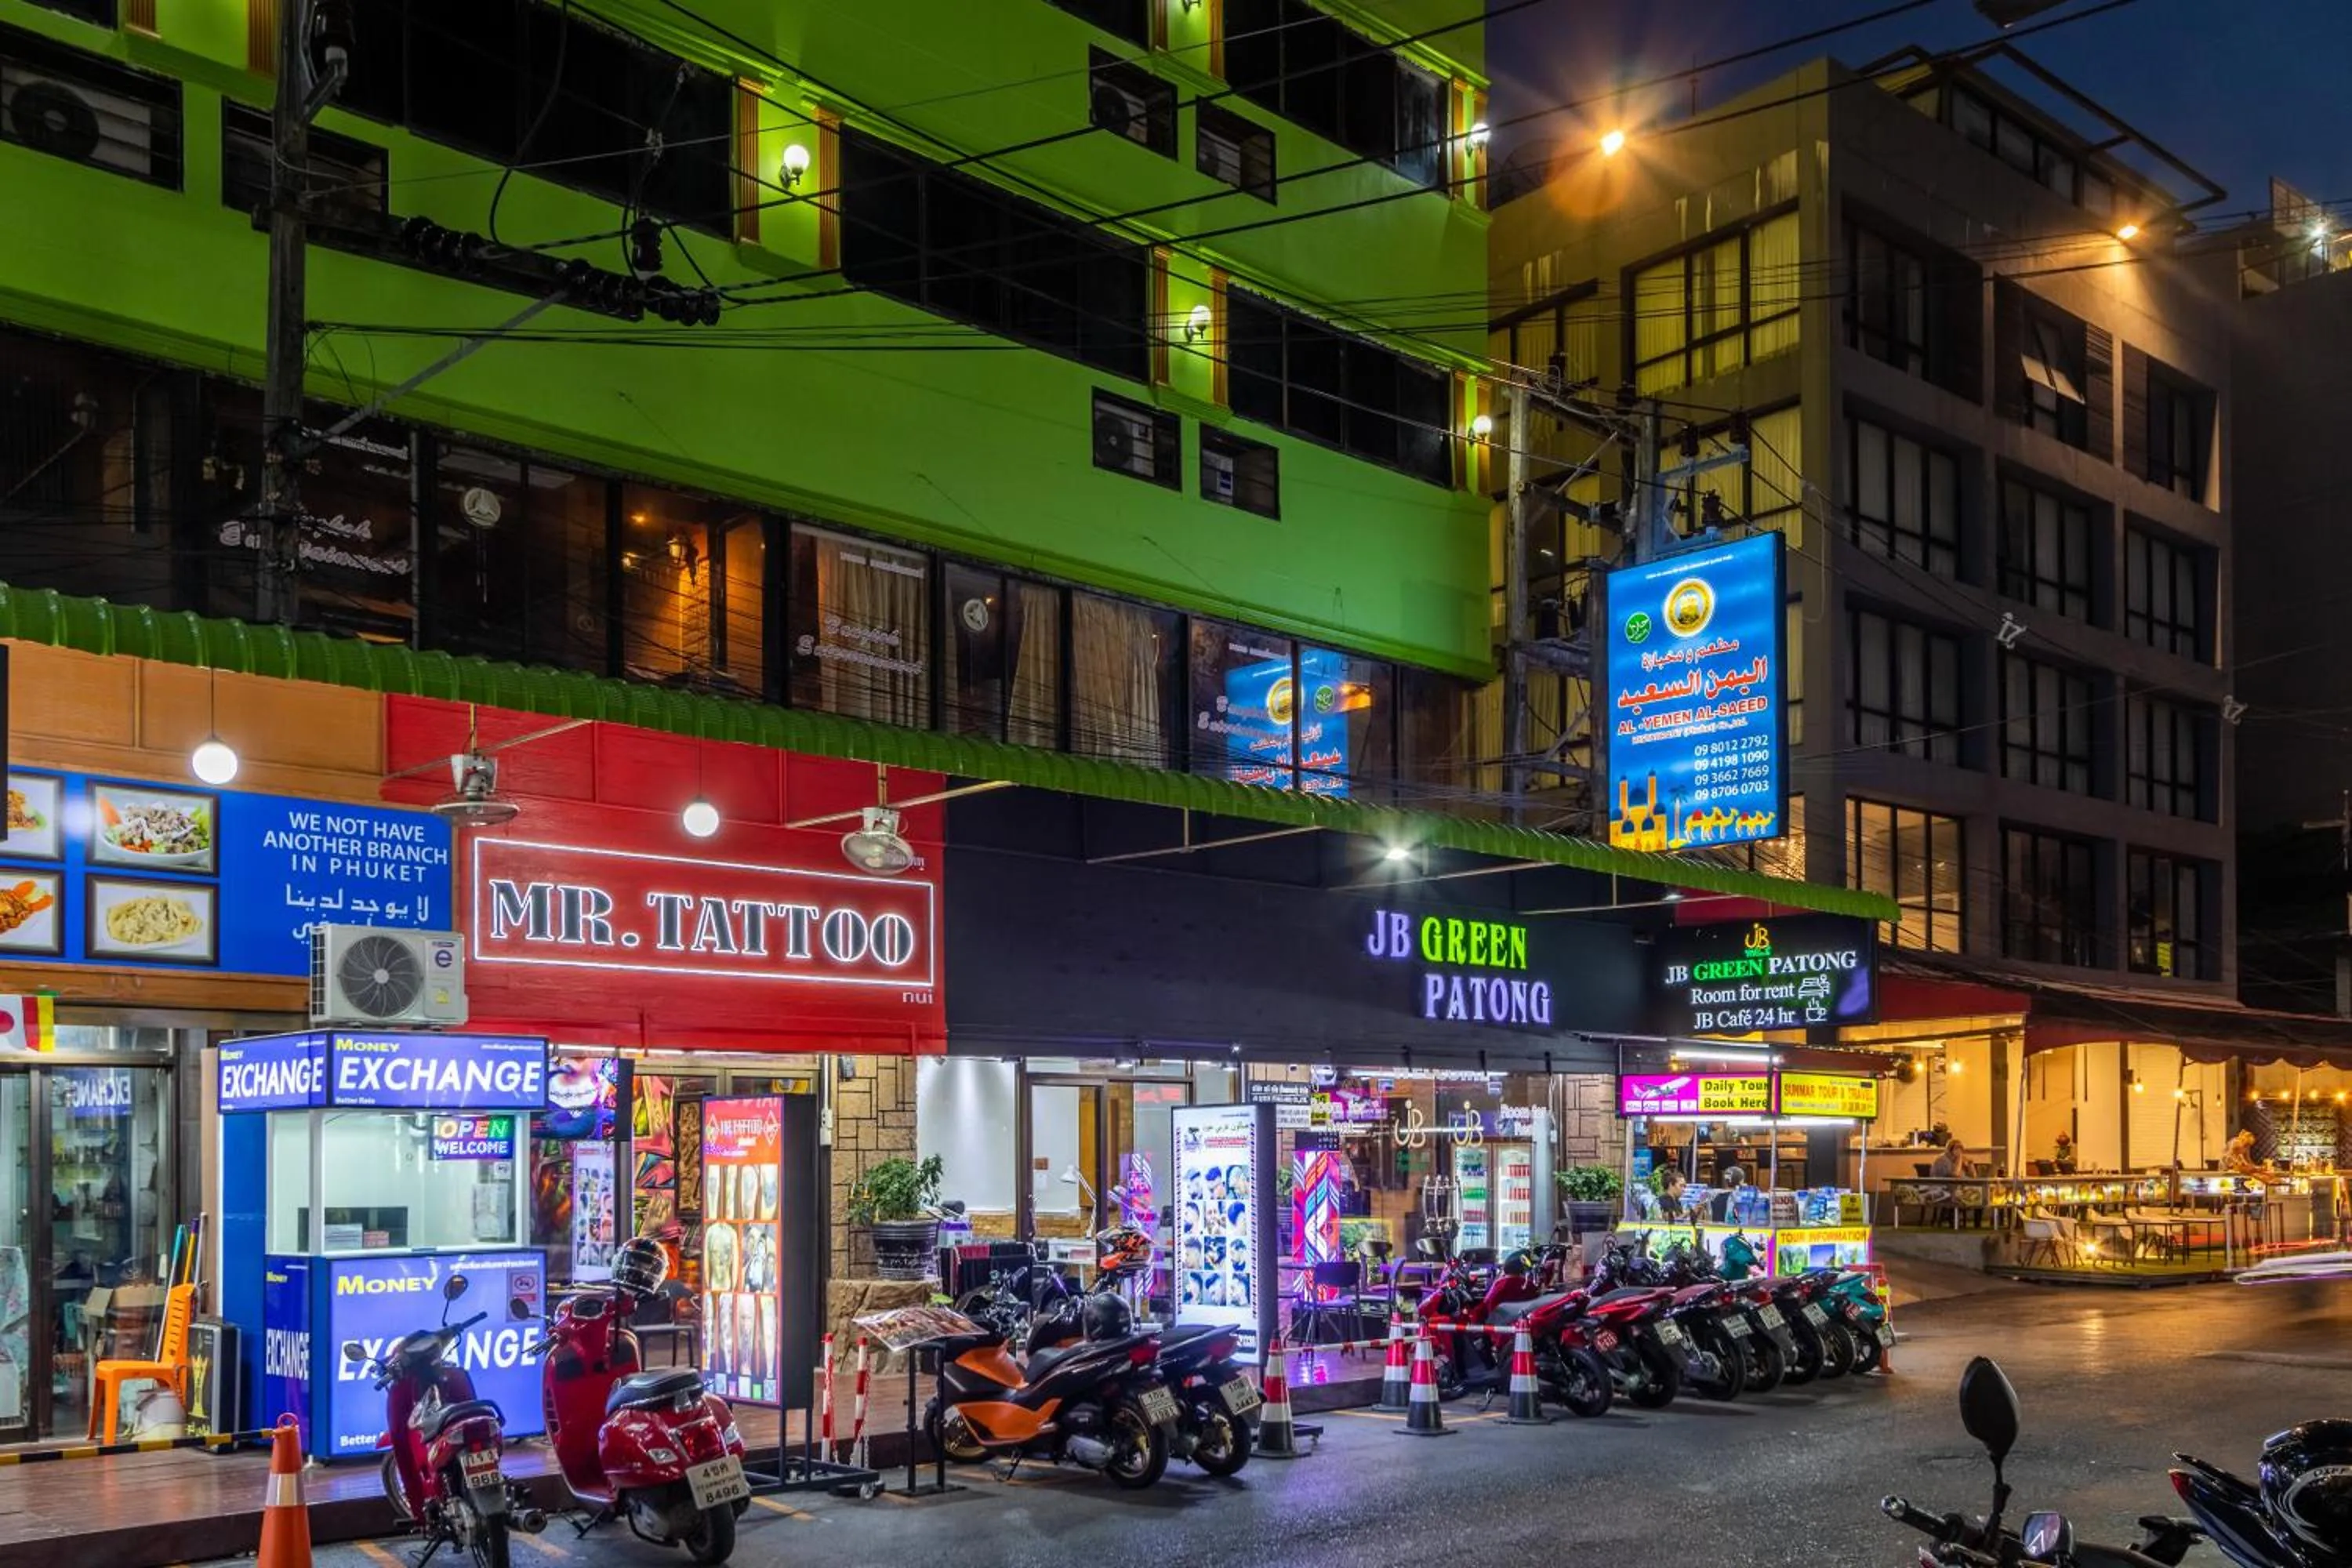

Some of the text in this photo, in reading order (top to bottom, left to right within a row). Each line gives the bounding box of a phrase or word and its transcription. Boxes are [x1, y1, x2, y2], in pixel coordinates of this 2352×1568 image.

[1618, 655, 1768, 714] اليمن السعيد
[1694, 735, 1768, 757] 09 8012 2792
[1694, 750, 1769, 771] 09 4198 1090
[1694, 765, 1769, 786] 09 3662 7669
[1694, 780, 1769, 800] 09 8706 0703
[289, 811, 425, 843] WE NOT HAVE
[263, 830, 448, 865] ANOTHER BRANCH
[292, 854, 426, 883] IN PHUKET
[285, 883, 344, 911] لدينا
[417, 895, 429, 922] لا
[488, 879, 914, 966] MR. TATTOO
[1368, 909, 1527, 969] JB GREEN
[1665, 966, 1688, 984] JB
[1693, 959, 1763, 980] GREEN
[1769, 951, 1857, 975] PATONG
[1425, 973, 1550, 1024] PATONG
[1691, 984, 1795, 1004] Room for rent
[1694, 1007, 1795, 1029] JB Café 24 hr
[222, 1056, 325, 1098] EXCHANGE
[338, 1056, 543, 1094] EXCHANGE
[1705, 1080, 1734, 1093] Daily
[1704, 1098, 1734, 1108] Book
[1740, 1098, 1769, 1108] Here
[439, 1120, 509, 1138] OPEN
[1395, 1099, 1426, 1148] JB
[1454, 1100, 1483, 1148] JB
[435, 1140, 508, 1155] WELCOME
[266, 1329, 310, 1381] EXCHANGE
[339, 1435, 377, 1447] Better
